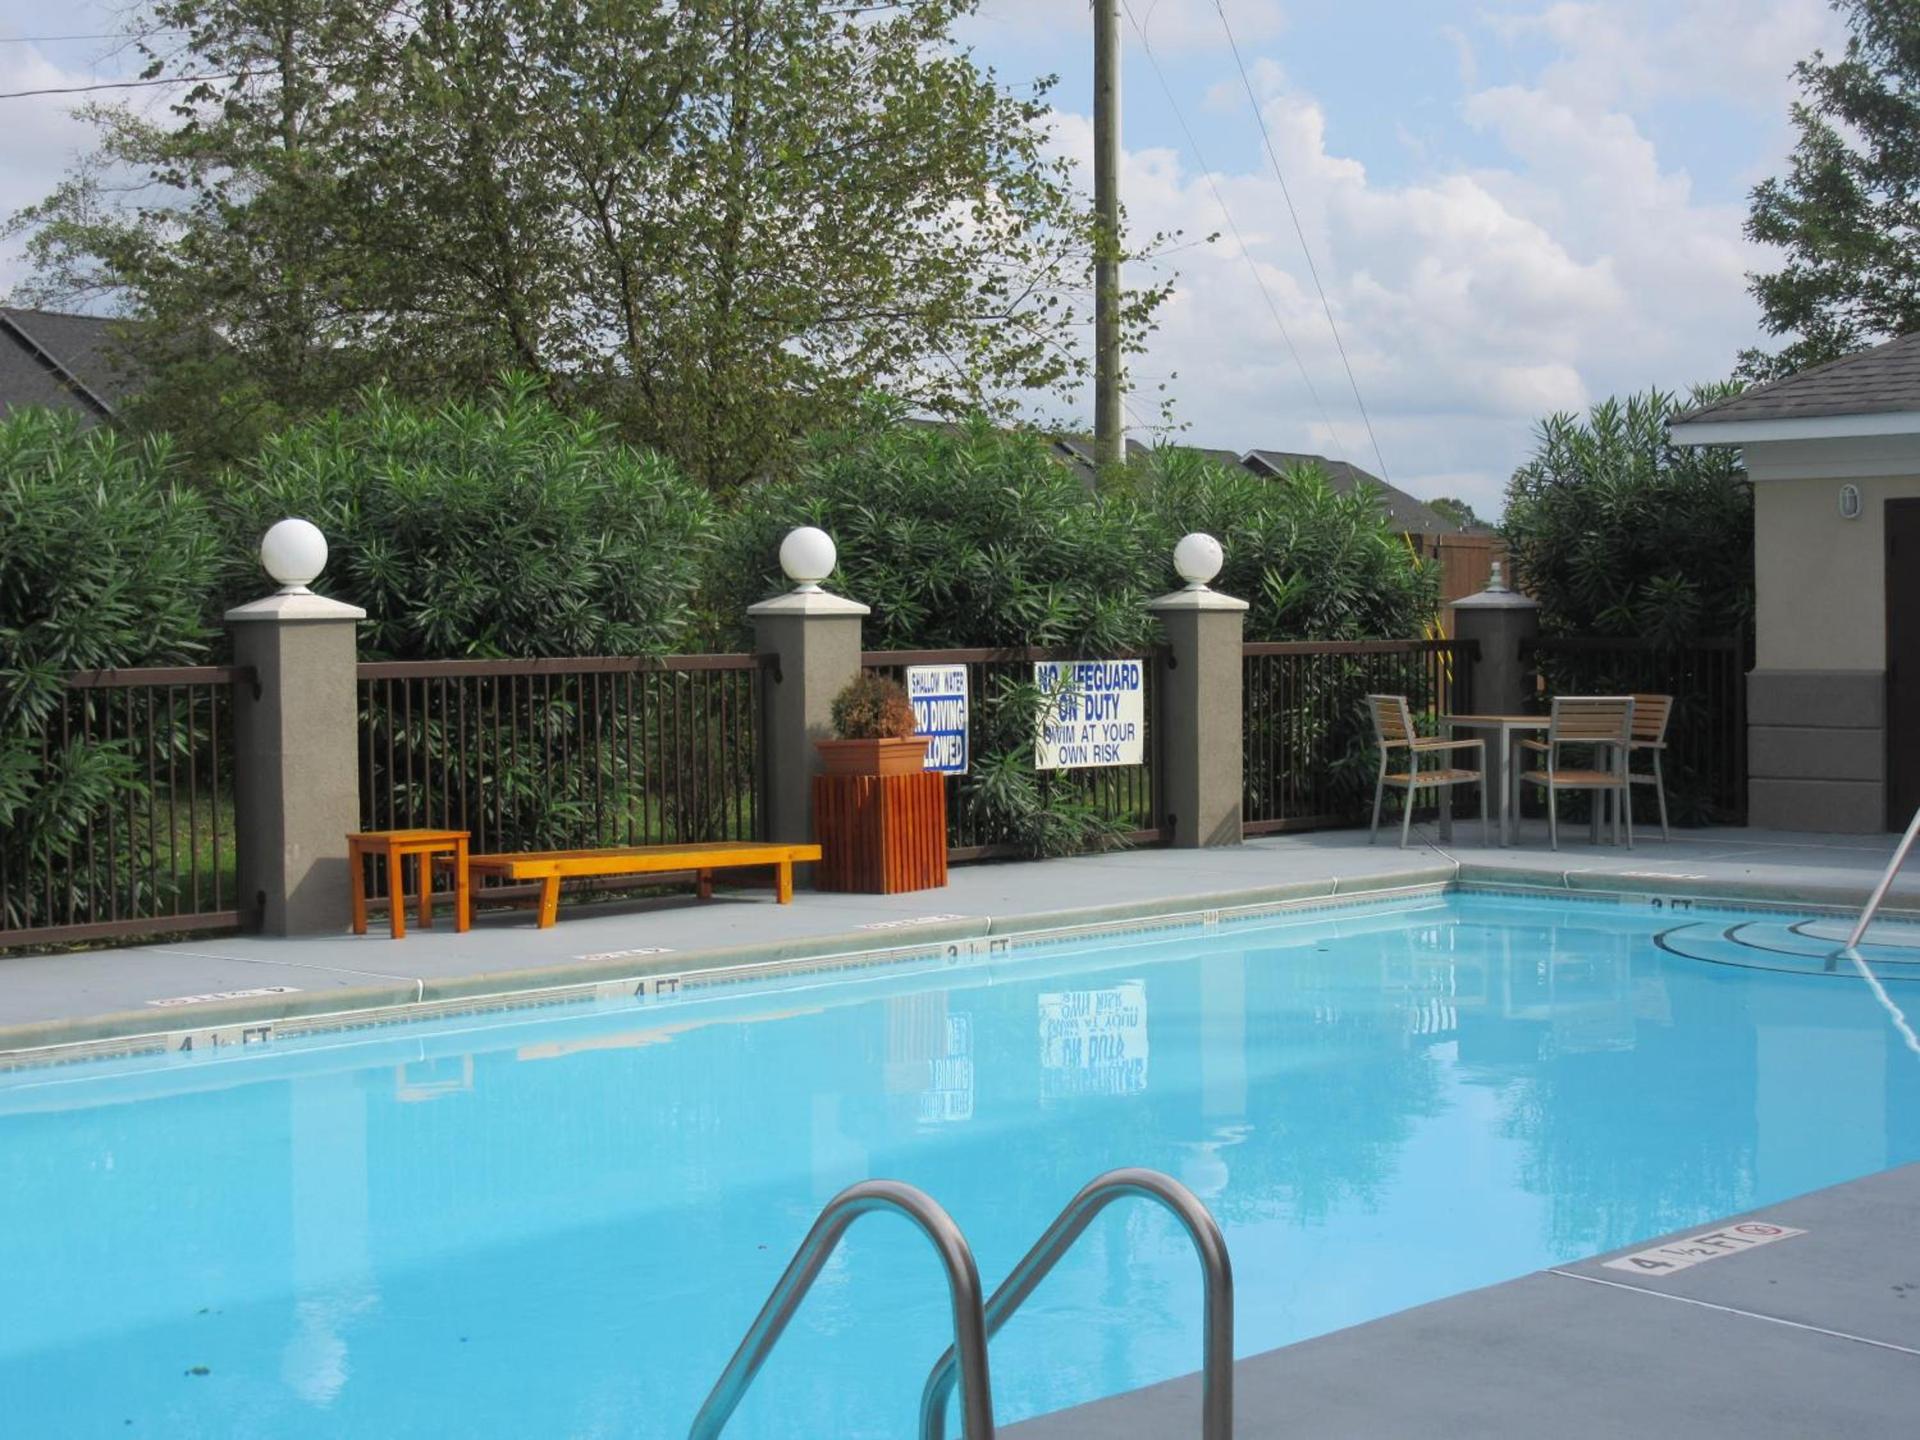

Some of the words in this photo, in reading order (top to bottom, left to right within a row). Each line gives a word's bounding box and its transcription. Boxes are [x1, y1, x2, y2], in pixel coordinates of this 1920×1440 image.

[912, 671, 939, 694] SHALLOW
[944, 670, 964, 693] WATER
[1066, 663, 1139, 692] IFEGUARD
[914, 700, 928, 733] NO
[930, 699, 964, 732] DIVING
[1059, 694, 1078, 722] ON
[1085, 693, 1120, 721] DUTY
[1044, 725, 1075, 745] SWIM
[1081, 724, 1096, 743] AT
[1102, 722, 1135, 742] YOUR
[1059, 745, 1087, 765] OWN
[1094, 743, 1120, 763] RISK
[1628, 1257, 1676, 1270] 4
[1693, 1232, 1756, 1249] FT
